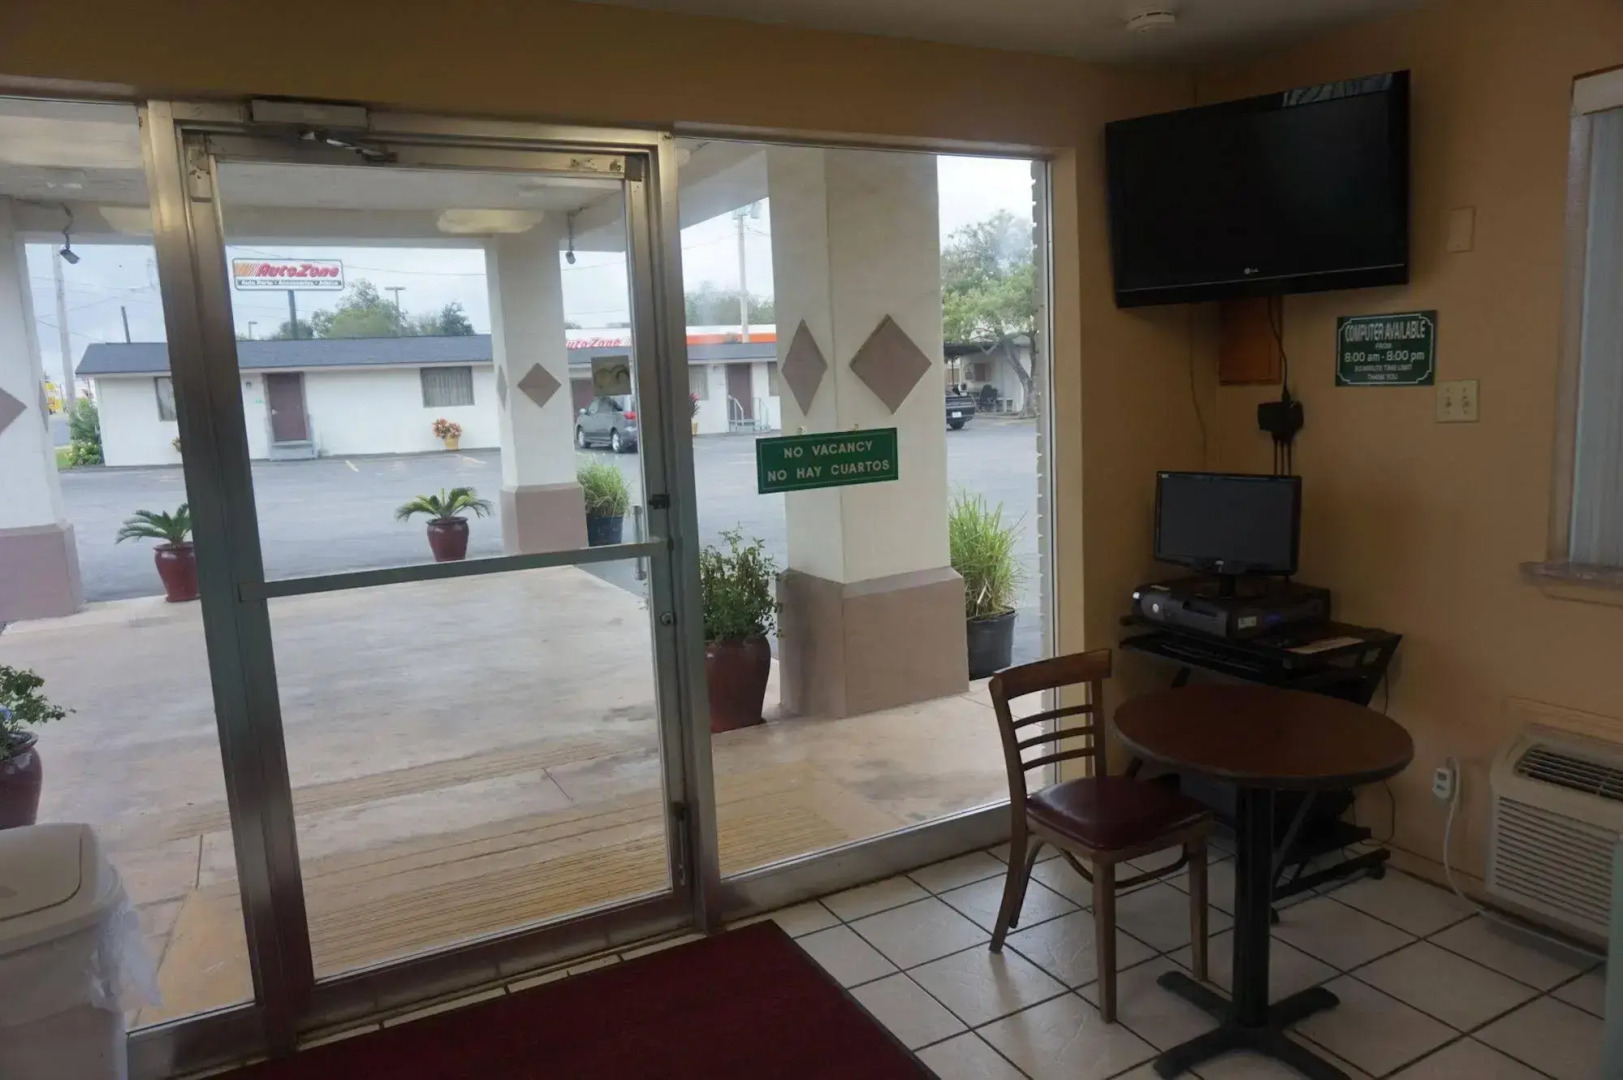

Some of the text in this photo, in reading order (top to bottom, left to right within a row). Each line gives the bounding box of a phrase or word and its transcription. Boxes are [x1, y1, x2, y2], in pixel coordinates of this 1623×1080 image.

[256, 263, 339, 277] AutoZone
[1345, 320, 1426, 342] COMPUTER AVAILABLE
[1344, 352, 1366, 362] 8:00
[1367, 353, 1380, 362] am
[1386, 350, 1409, 361] 8:00
[1410, 352, 1425, 363] pm
[784, 440, 873, 459] NO VACANCY
[767, 459, 890, 482] NO HAY CUARTOS
